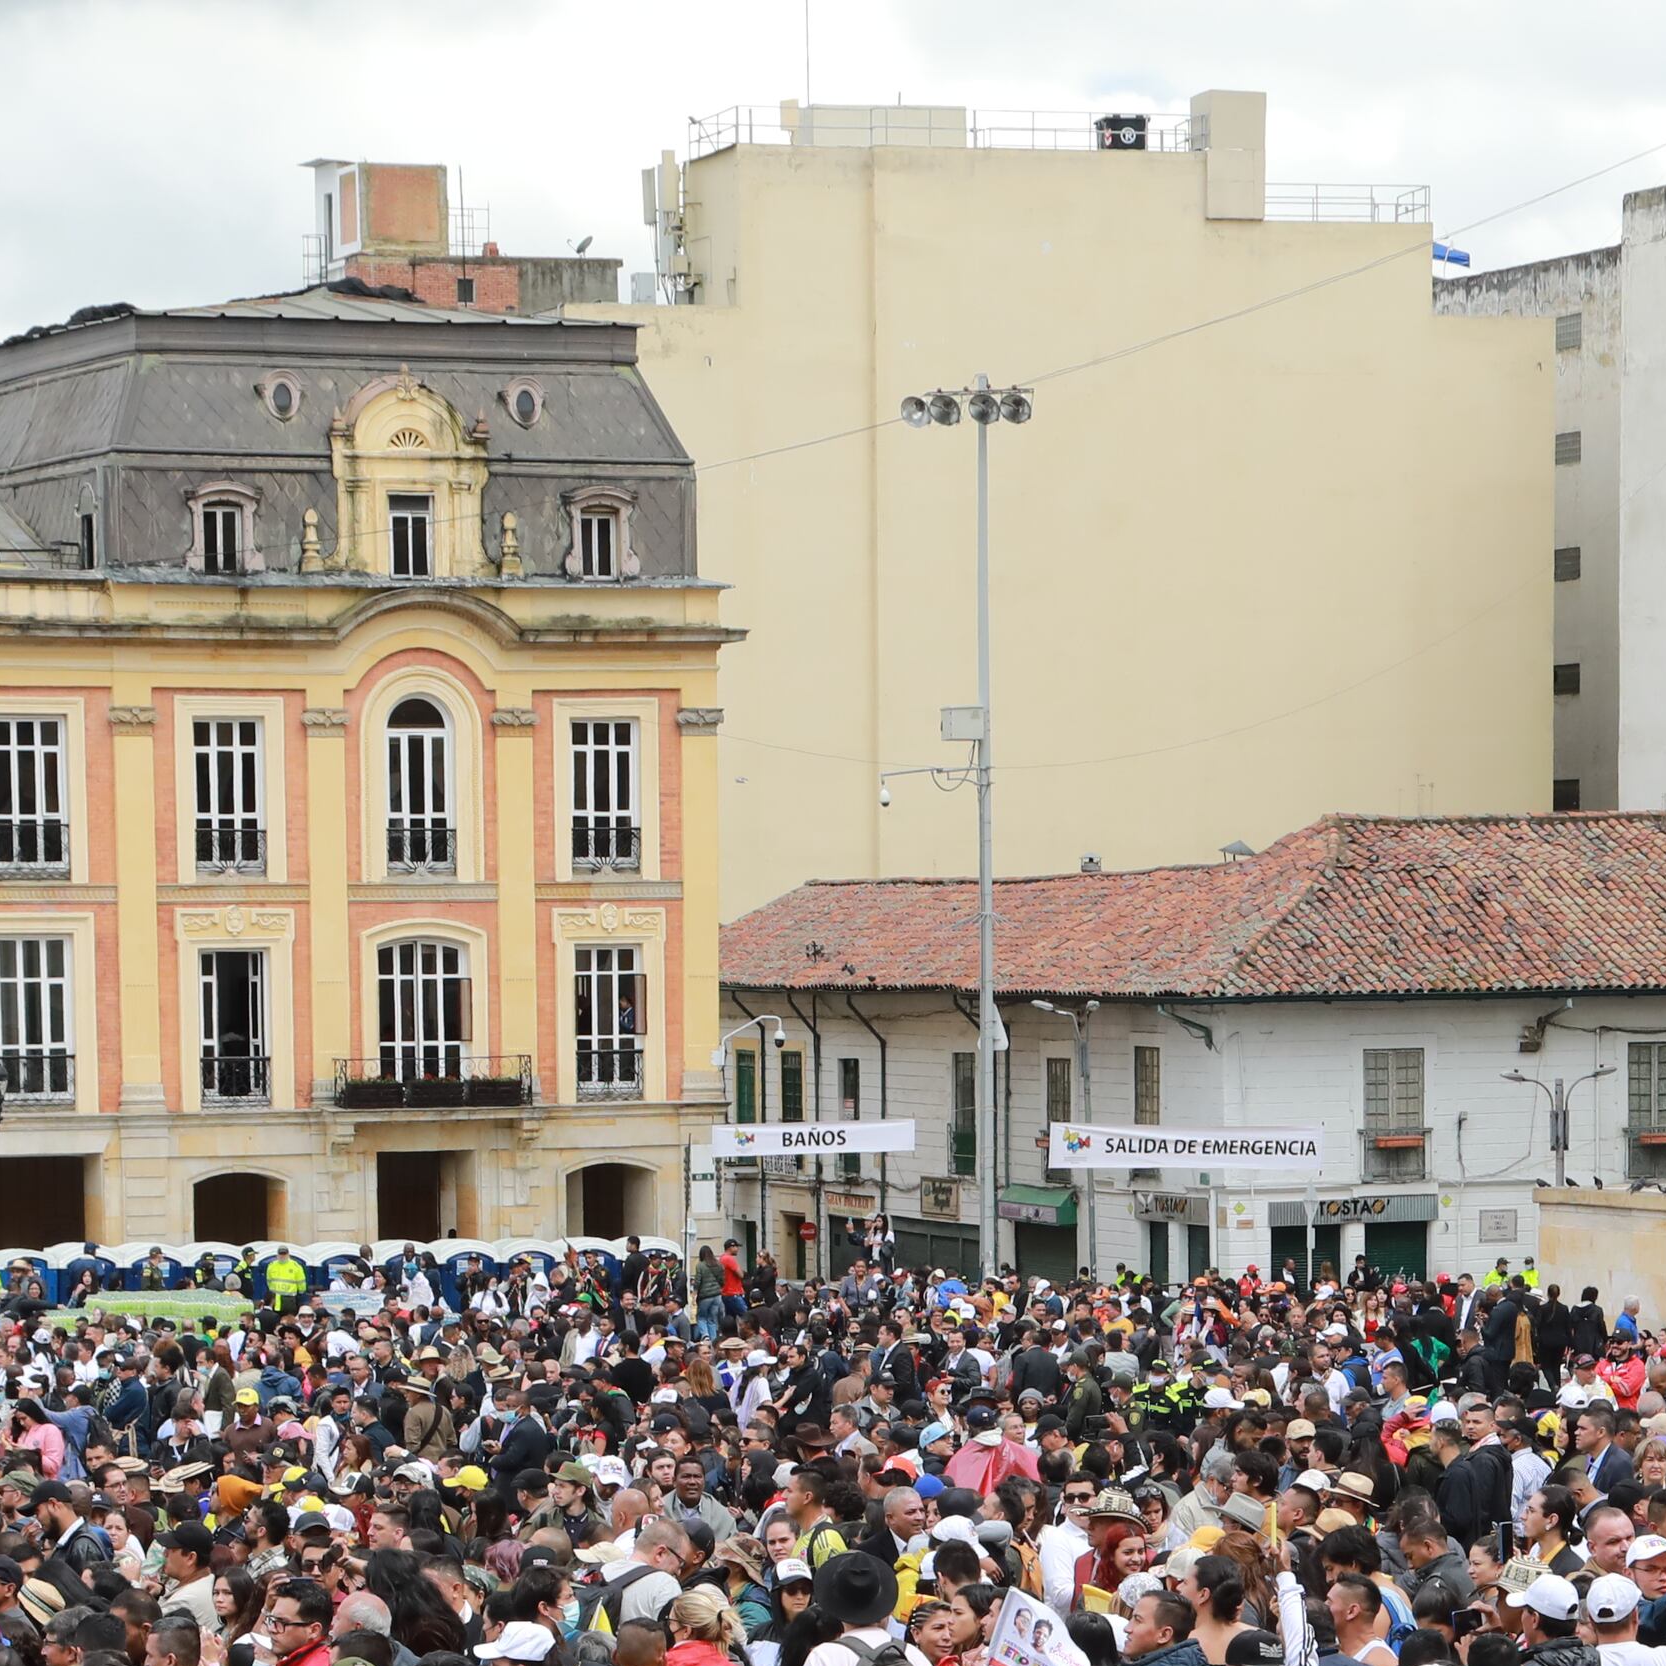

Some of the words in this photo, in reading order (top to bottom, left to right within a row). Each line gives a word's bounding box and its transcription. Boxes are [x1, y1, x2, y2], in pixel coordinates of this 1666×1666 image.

[782, 1127, 847, 1147] BAÑOS
[1104, 1138, 1169, 1154] SALIDA
[1173, 1139, 1197, 1154] DE
[1201, 1139, 1317, 1157] EMERGENCIA
